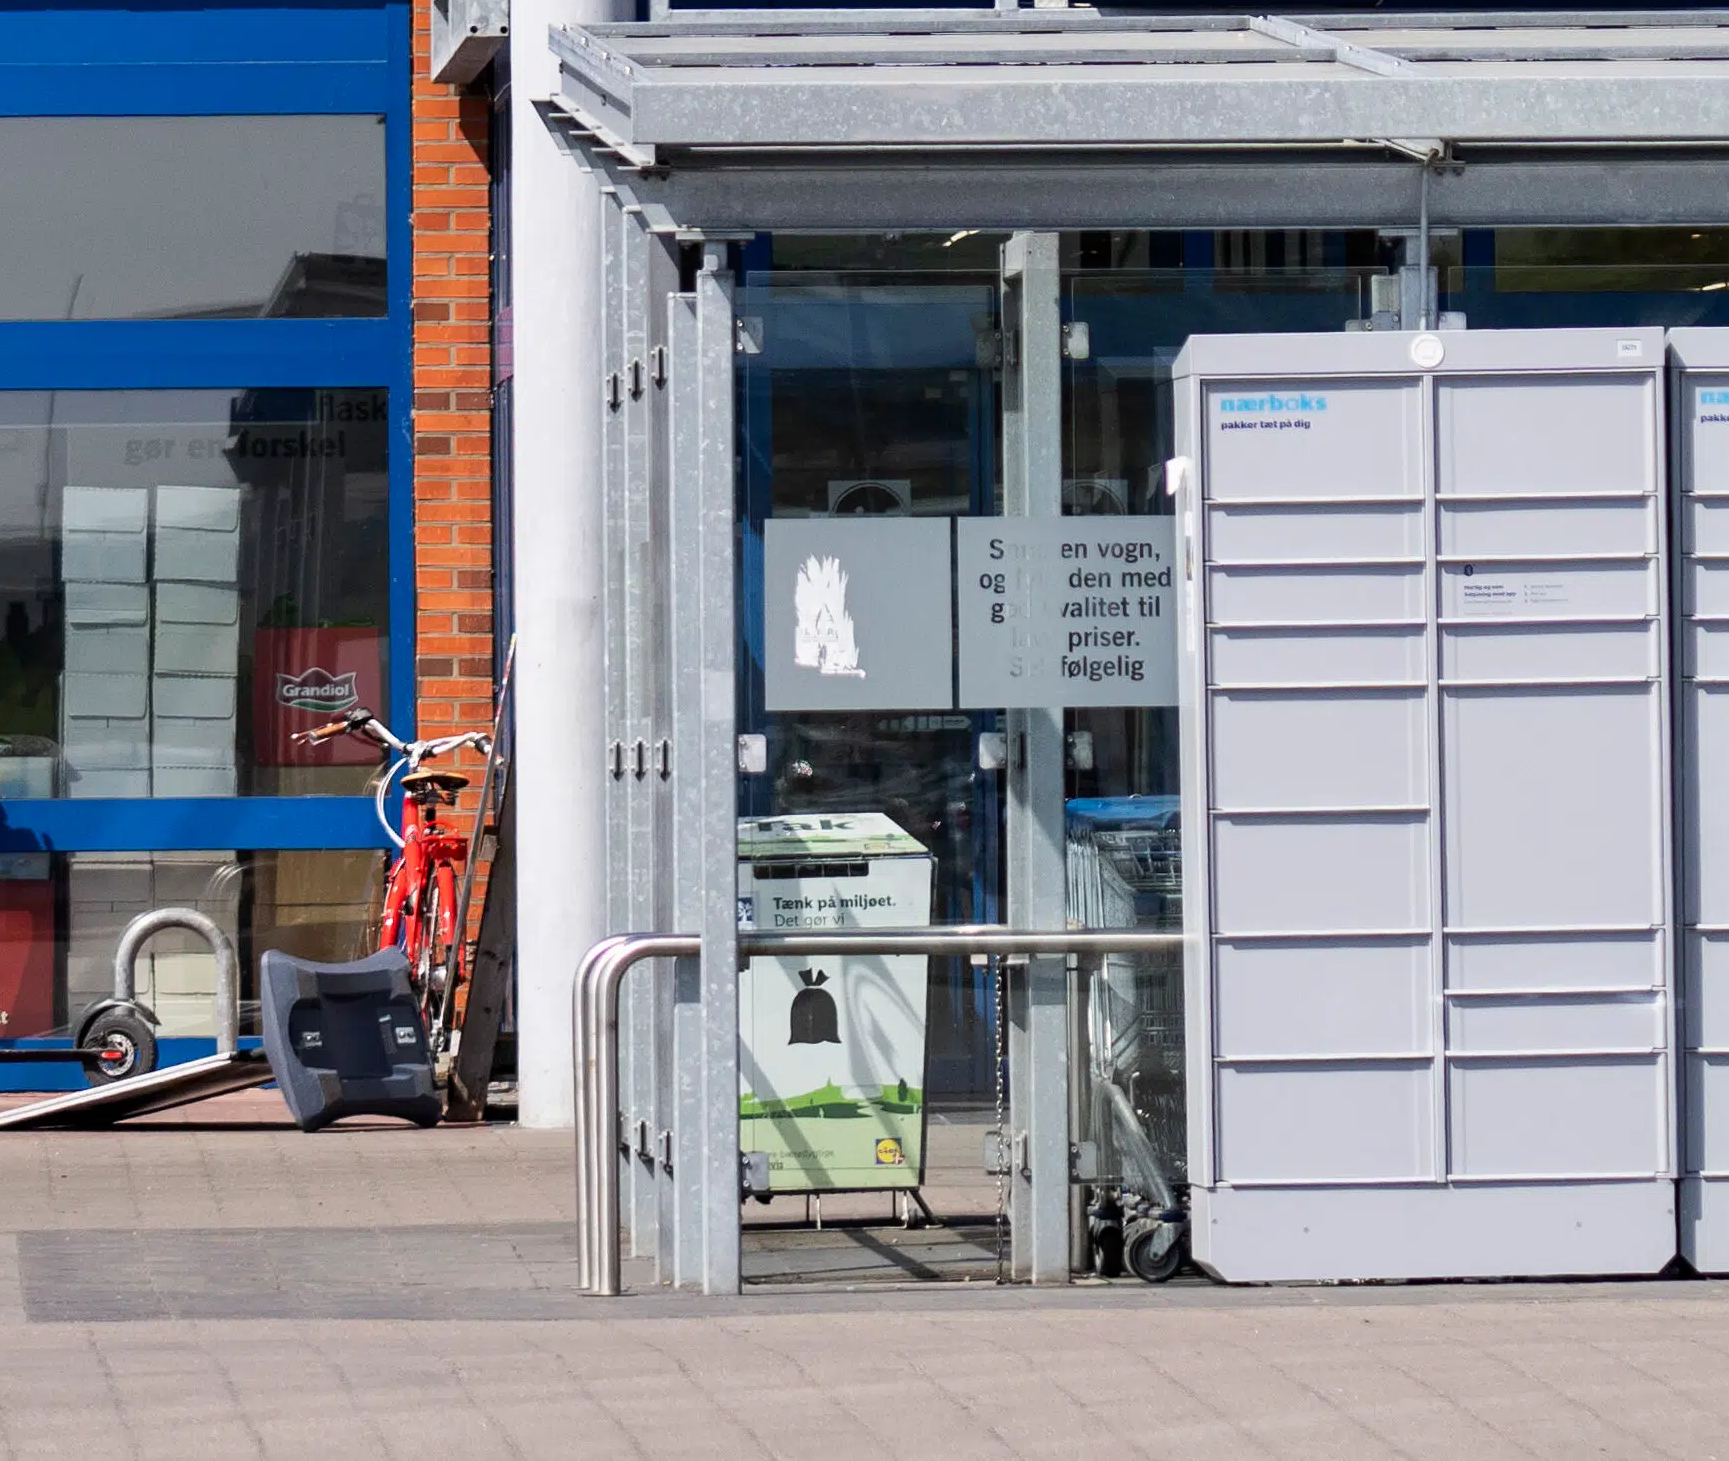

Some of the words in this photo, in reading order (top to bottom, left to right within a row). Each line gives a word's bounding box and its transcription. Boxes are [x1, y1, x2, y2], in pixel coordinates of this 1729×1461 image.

[1220, 393, 1328, 412] nærboks
[1221, 420, 1258, 431] pakker
[1260, 420, 1278, 429] tæt
[1279, 418, 1292, 430] på
[1294, 418, 1311, 430] dig
[1060, 542, 1088, 559] en
[1097, 542, 1161, 564] vogn,
[979, 572, 1006, 594] og
[1068, 566, 1112, 589] den
[1121, 566, 1172, 589] med
[1138, 594, 1161, 618] til
[1068, 626, 1141, 653] priser.
[282, 683, 351, 698] Grandiol
[772, 895, 813, 911] Tænk
[817, 894, 836, 913] på
[839, 892, 898, 911] miljøet.
[773, 912, 800, 927] Det
[803, 916, 827, 929] gør
[831, 912, 846, 926] vi
